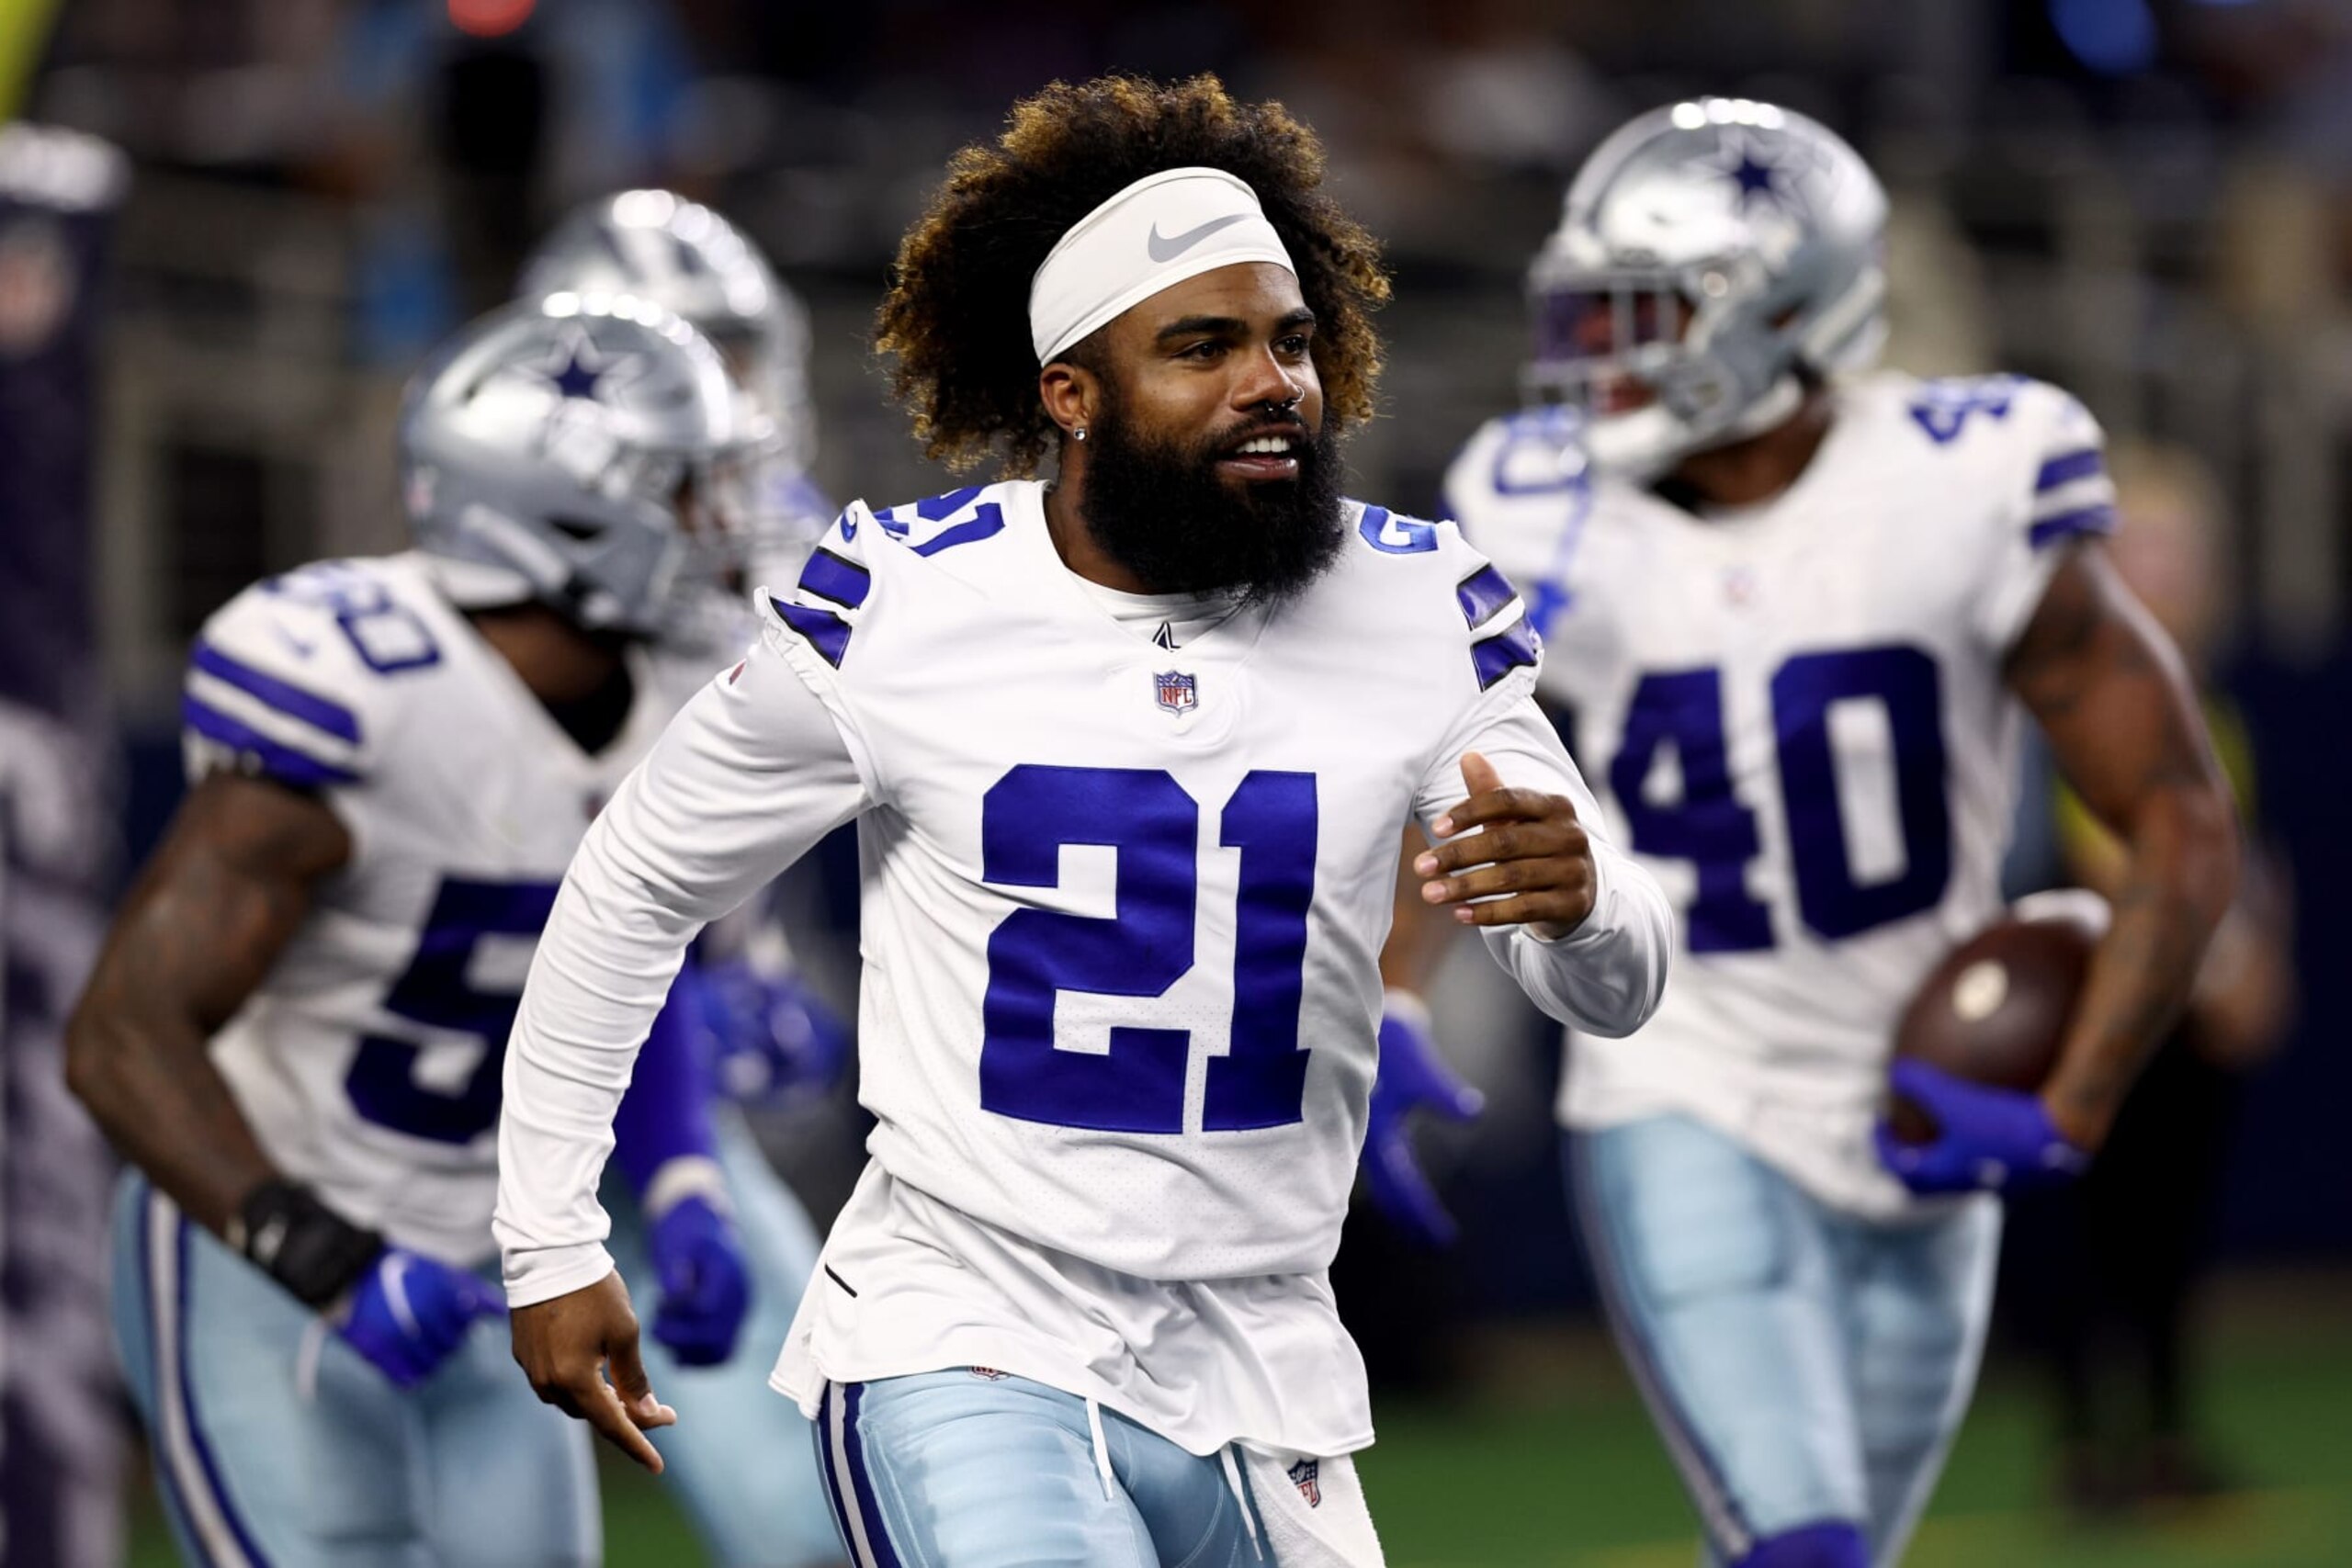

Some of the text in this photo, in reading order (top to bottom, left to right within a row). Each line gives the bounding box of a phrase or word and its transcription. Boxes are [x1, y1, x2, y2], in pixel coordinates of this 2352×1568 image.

[1161, 687, 1193, 705] NFL
[1609, 642, 1950, 954] 40
[979, 763, 1318, 1135] 21
